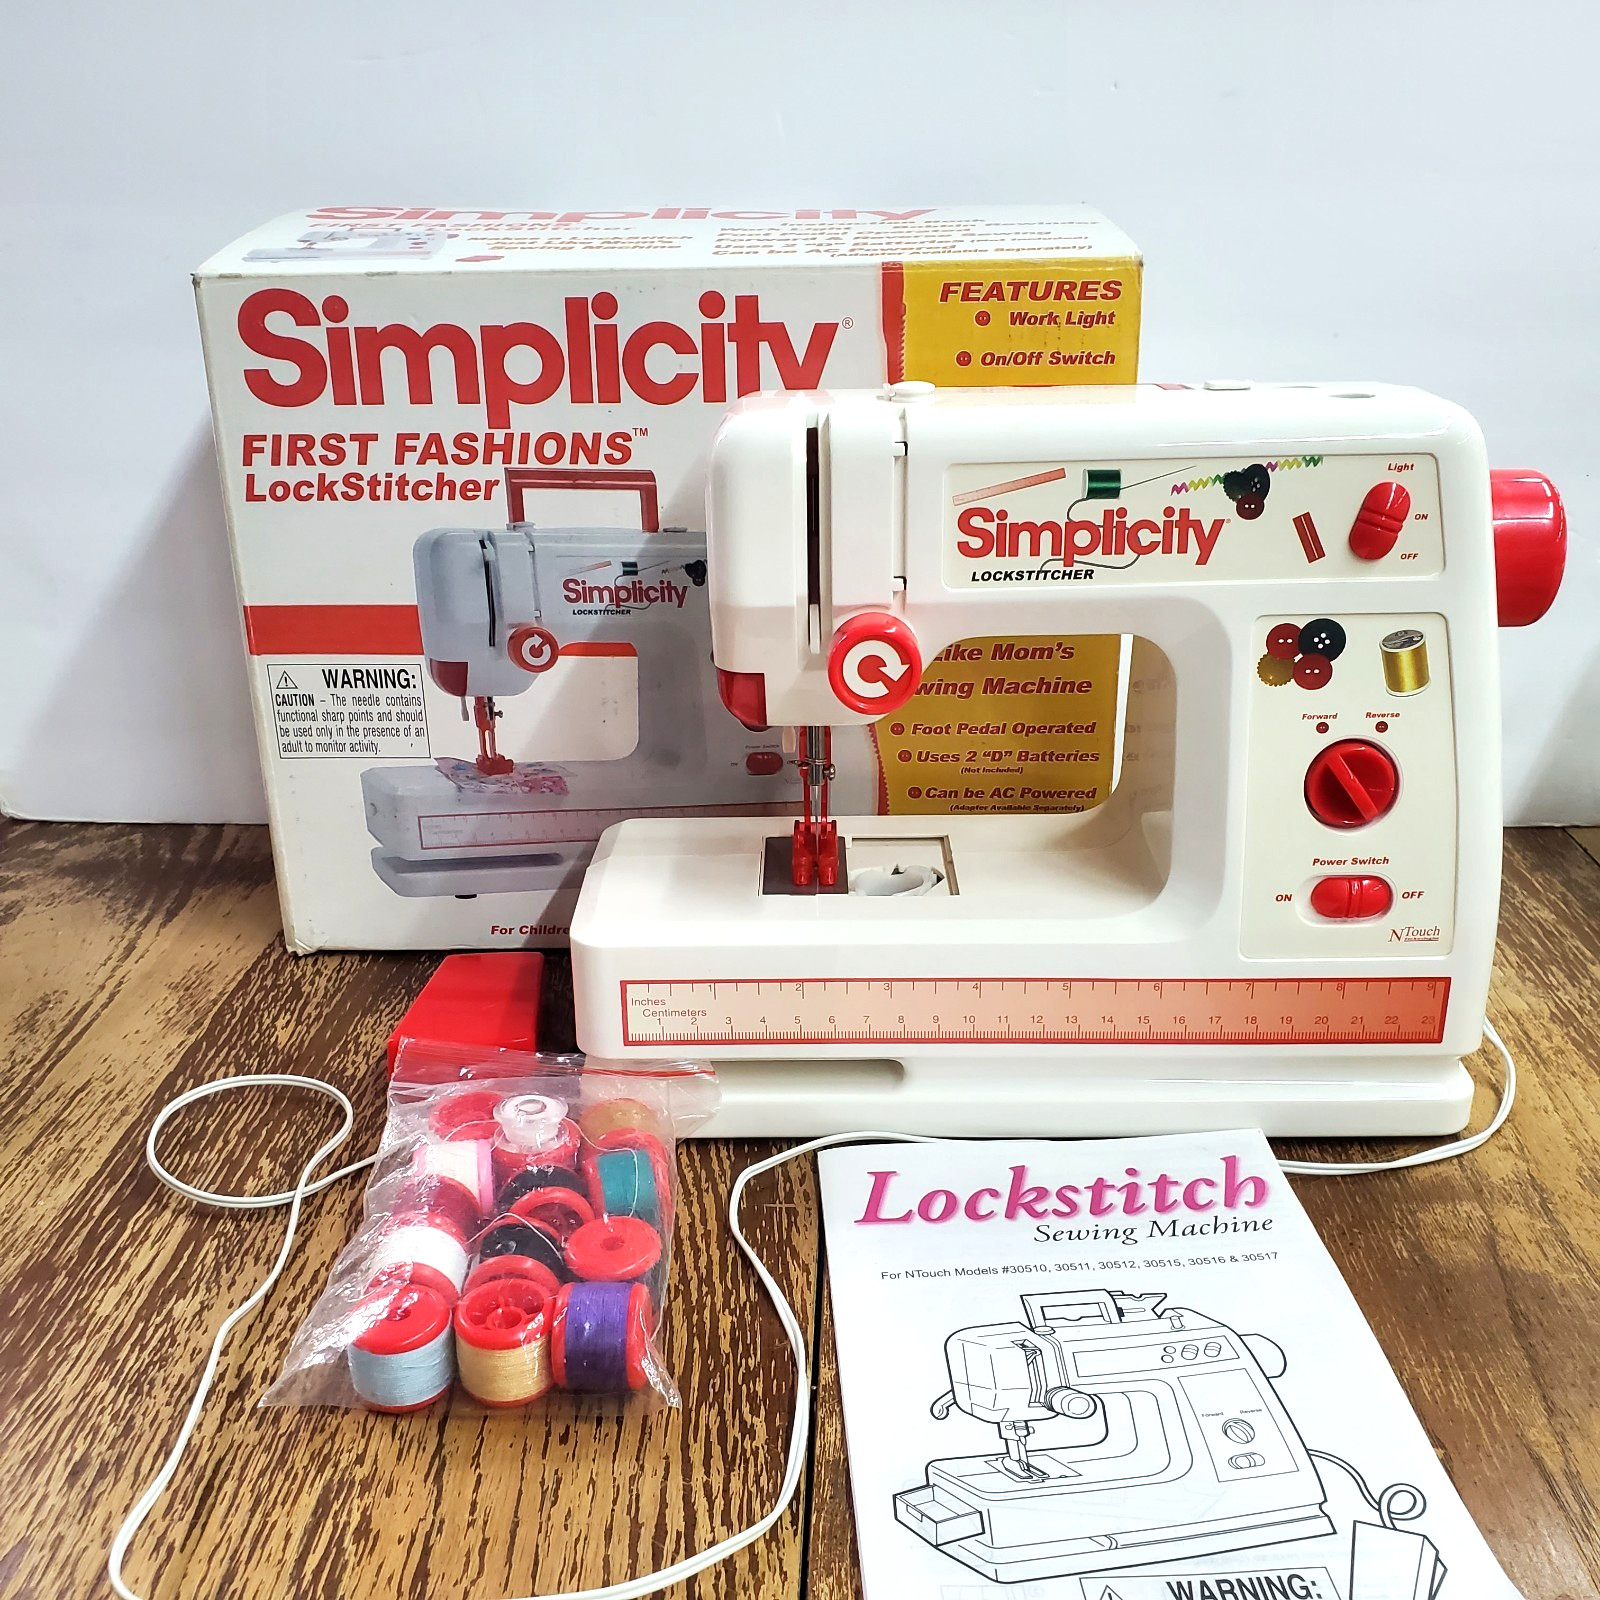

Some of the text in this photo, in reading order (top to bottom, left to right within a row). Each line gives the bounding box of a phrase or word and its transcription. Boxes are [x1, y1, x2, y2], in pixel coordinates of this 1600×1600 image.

[306, 206, 938, 223] Simplicity
[848, 244, 957, 253] Powered
[938, 278, 1123, 305] FEATURES
[1008, 308, 1118, 331] Work Light
[979, 349, 1117, 369] On/Off Switch
[242, 433, 379, 468] FIRST
[1385, 461, 1416, 474] Light
[243, 472, 502, 503] LockStitcher
[1413, 511, 1430, 521] ON
[955, 506, 1232, 570] Simplicity
[1399, 551, 1420, 562] OFF
[970, 569, 1096, 583] LOCKSTITCHER
[561, 578, 690, 609] Simplicity
[572, 608, 632, 617] LOCKSTITCHER
[932, 643, 984, 662] ike
[321, 668, 418, 689] WARNING:
[914, 676, 1093, 699] wing Machine
[275, 693, 316, 707] CAUTION
[330, 693, 348, 707] The
[351, 693, 382, 707] needle
[384, 693, 422, 707] contains
[277, 709, 424, 725] functional sharp points and should
[1301, 712, 1339, 722] Forward
[1365, 711, 1401, 720] Reverse
[279, 725, 425, 740] be used only in the presence of an
[911, 721, 1097, 737] Foot Pedal Operated
[282, 741, 381, 756] adult to monitor activity.
[916, 750, 960, 764] Uses
[965, 750, 979, 763] 2
[1016, 748, 1100, 763] Batteries
[960, 766, 1024, 775] (Not Included)
[924, 786, 1098, 801] Can be AC Powered
[989, 804, 1030, 812] Available
[1312, 856, 1390, 867] Power Switch
[1275, 894, 1293, 903] ON
[1401, 891, 1425, 901] OFF
[490, 925, 515, 936] For
[1387, 925, 1441, 943] NTouch
[795, 984, 802, 992] 2
[883, 983, 890, 991] 3
[972, 983, 979, 991] 4
[1062, 983, 1069, 991] 5
[1153, 983, 1160, 992] 6
[1244, 983, 1250, 992] 7
[1334, 983, 1342, 992] 8
[631, 998, 667, 1007] Inches
[642, 1009, 708, 1018] Centimeters
[691, 1017, 698, 1026] 2
[725, 1017, 732, 1025] 3
[760, 1016, 767, 1024] 4
[795, 1016, 801, 1025] 5
[829, 1016, 836, 1024] 6
[864, 1015, 870, 1024] 7
[898, 1015, 905, 1024] 8
[933, 1015, 940, 1024] 9
[963, 1015, 976, 1024] 10
[999, 1015, 1009, 1024] 11
[1032, 1015, 1044, 1024] 12
[1067, 1015, 1078, 1024] 13
[1102, 1015, 1114, 1024] 14
[1138, 1015, 1150, 1024] 15
[1173, 1016, 1186, 1025] 16
[1209, 1016, 1222, 1025] 17
[1245, 1016, 1257, 1025] 18
[1280, 1016, 1292, 1025] 19
[1314, 1016, 1328, 1025] 20
[1350, 1016, 1362, 1025] 21
[1384, 1016, 1398, 1025] 22
[854, 1154, 1270, 1225] Lockstitch
[1033, 1217, 1274, 1246] Sewing Machine
[880, 1251, 1279, 1280] For NTouch Models #30510, 30511, 30512, 30515, 30516 & 30517
[1165, 1573, 1323, 1600] WARNING:
